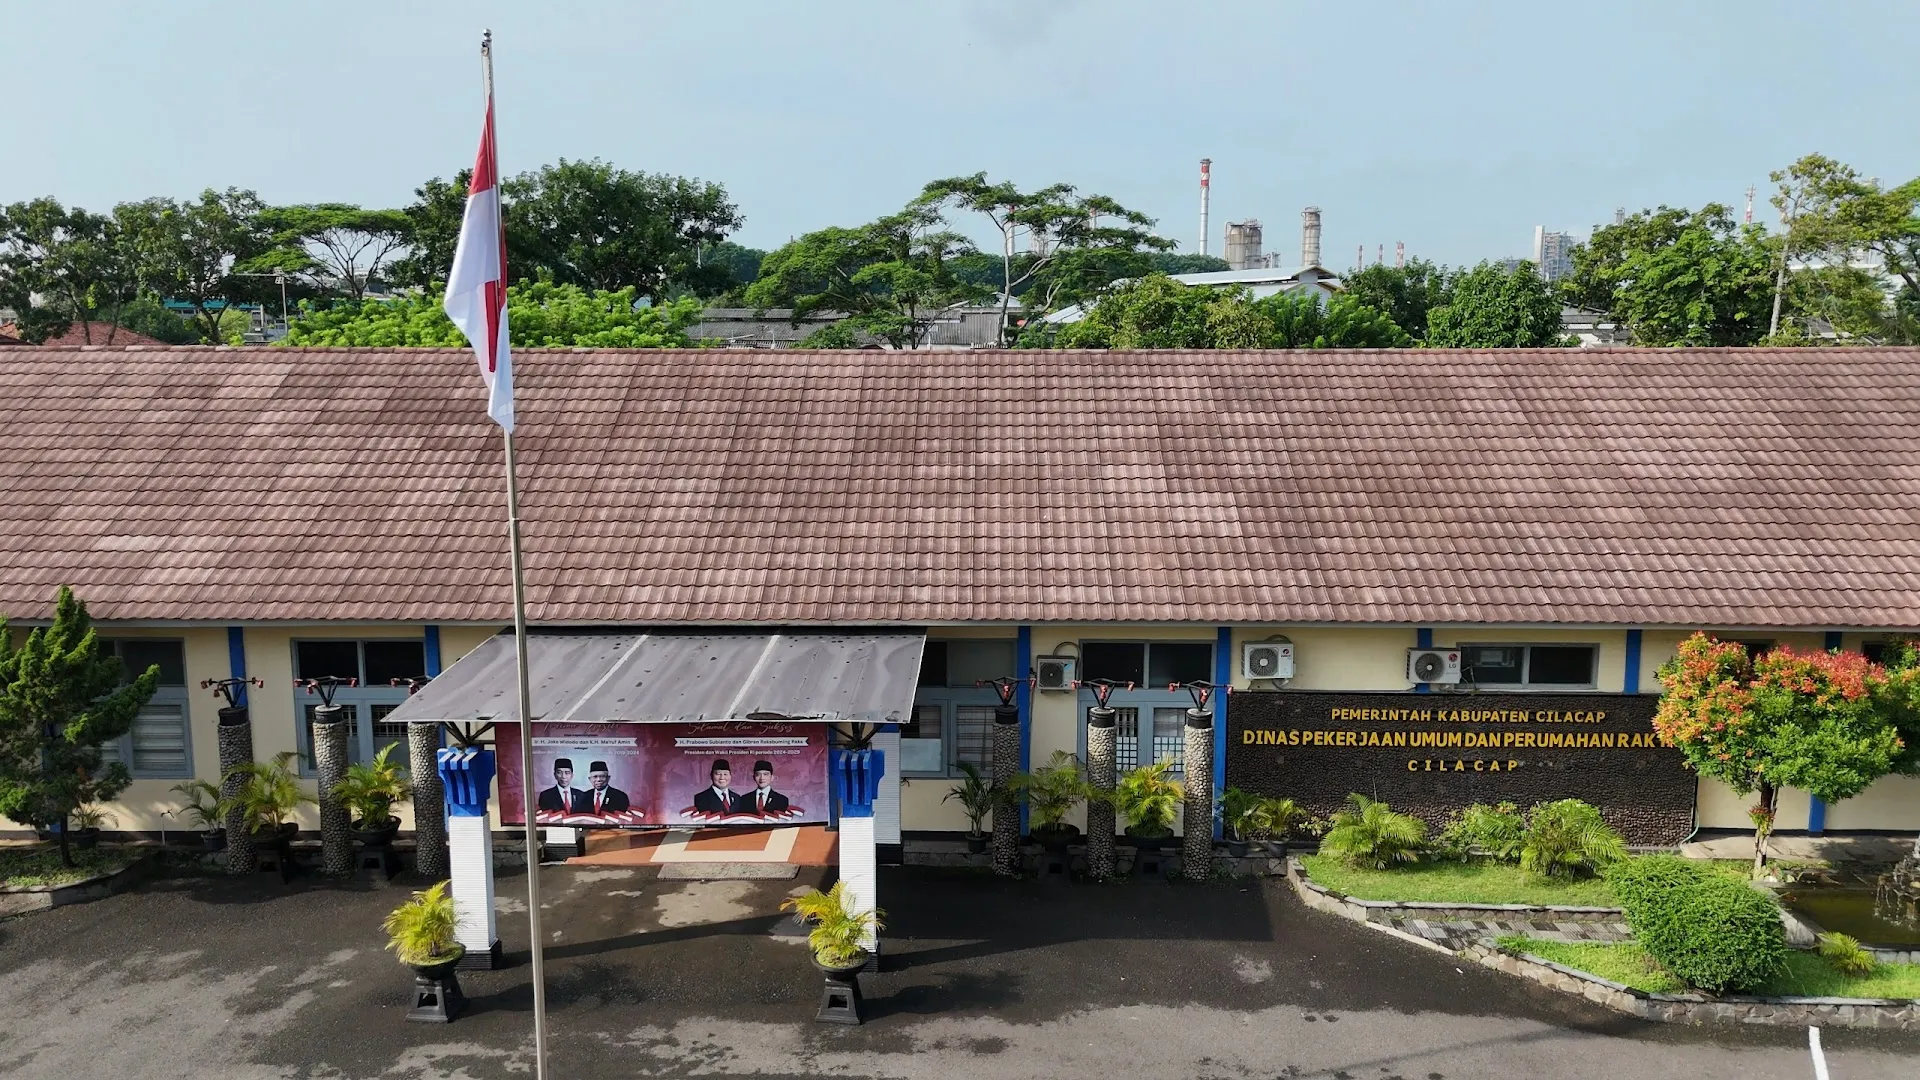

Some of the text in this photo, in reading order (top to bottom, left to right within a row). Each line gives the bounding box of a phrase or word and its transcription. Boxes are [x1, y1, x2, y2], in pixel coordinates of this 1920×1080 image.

[1331, 708, 1606, 723] PEMERINTAH KABUPATEN CILACAP
[1243, 730, 1300, 746] DINAS
[1302, 731, 1406, 747] PEKERJAAN
[1410, 732, 1462, 747] UMUM
[1464, 732, 1501, 747] DAN
[1504, 732, 1614, 748] PERUMAHAN
[1407, 760, 1518, 772] CILACAP
